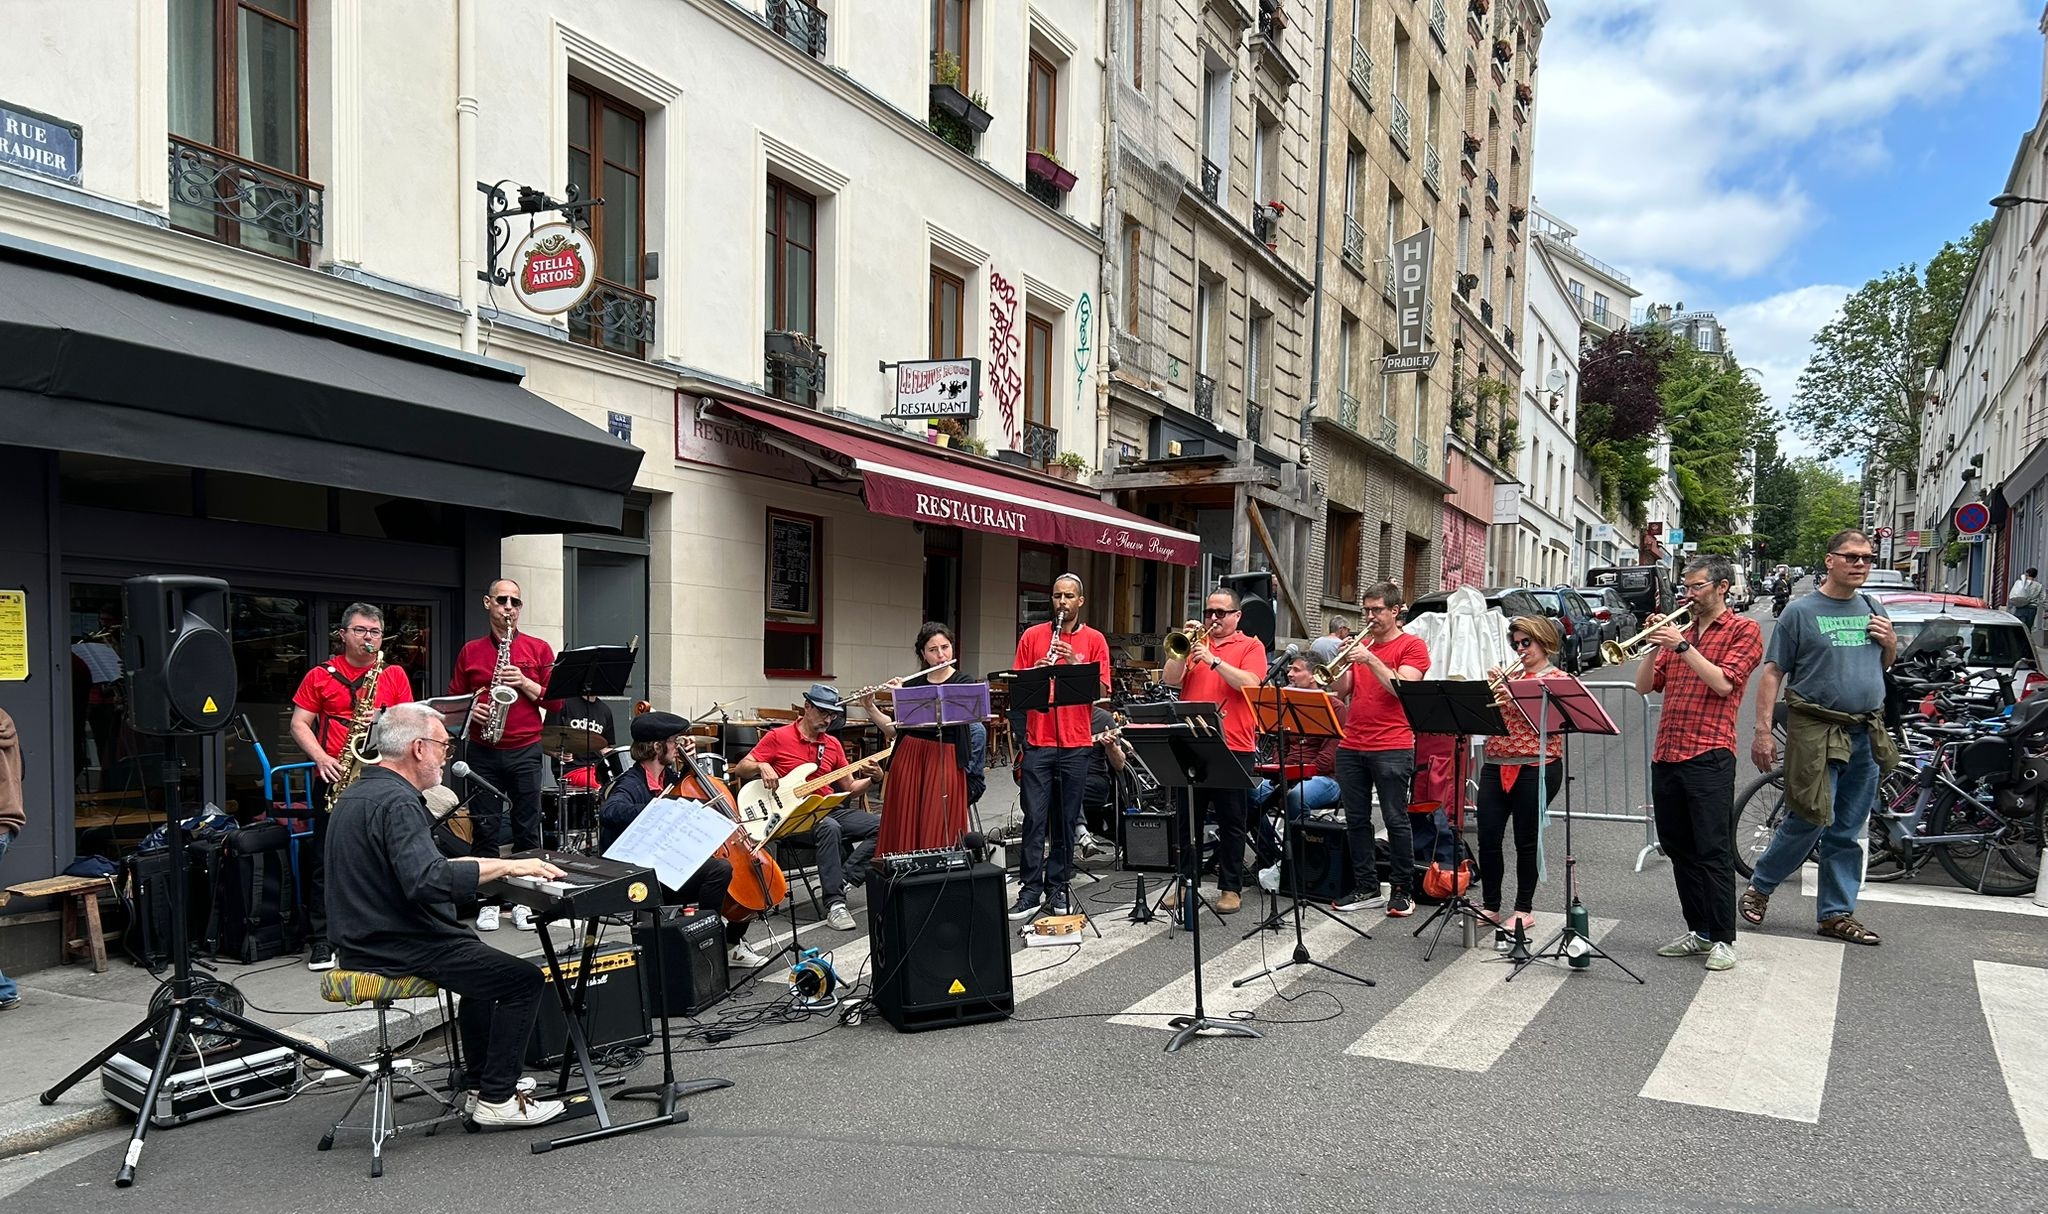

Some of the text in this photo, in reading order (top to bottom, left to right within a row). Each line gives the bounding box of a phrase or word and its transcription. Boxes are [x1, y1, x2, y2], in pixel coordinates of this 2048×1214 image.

[6, 117, 47, 144] RUE
[532, 256, 574, 273] STELLA
[532, 268, 574, 285] ARTOIS
[1402, 241, 1422, 347] HOTEL
[1387, 355, 1430, 369] PRADIER
[901, 401, 967, 415] RESTAURANT
[614, 414, 626, 423] GAZ
[915, 493, 1027, 532] RESTAURANT
[1096, 528, 1112, 545] Le
[1115, 531, 1144, 551] Fleuve
[570, 718, 604, 734] adidas
